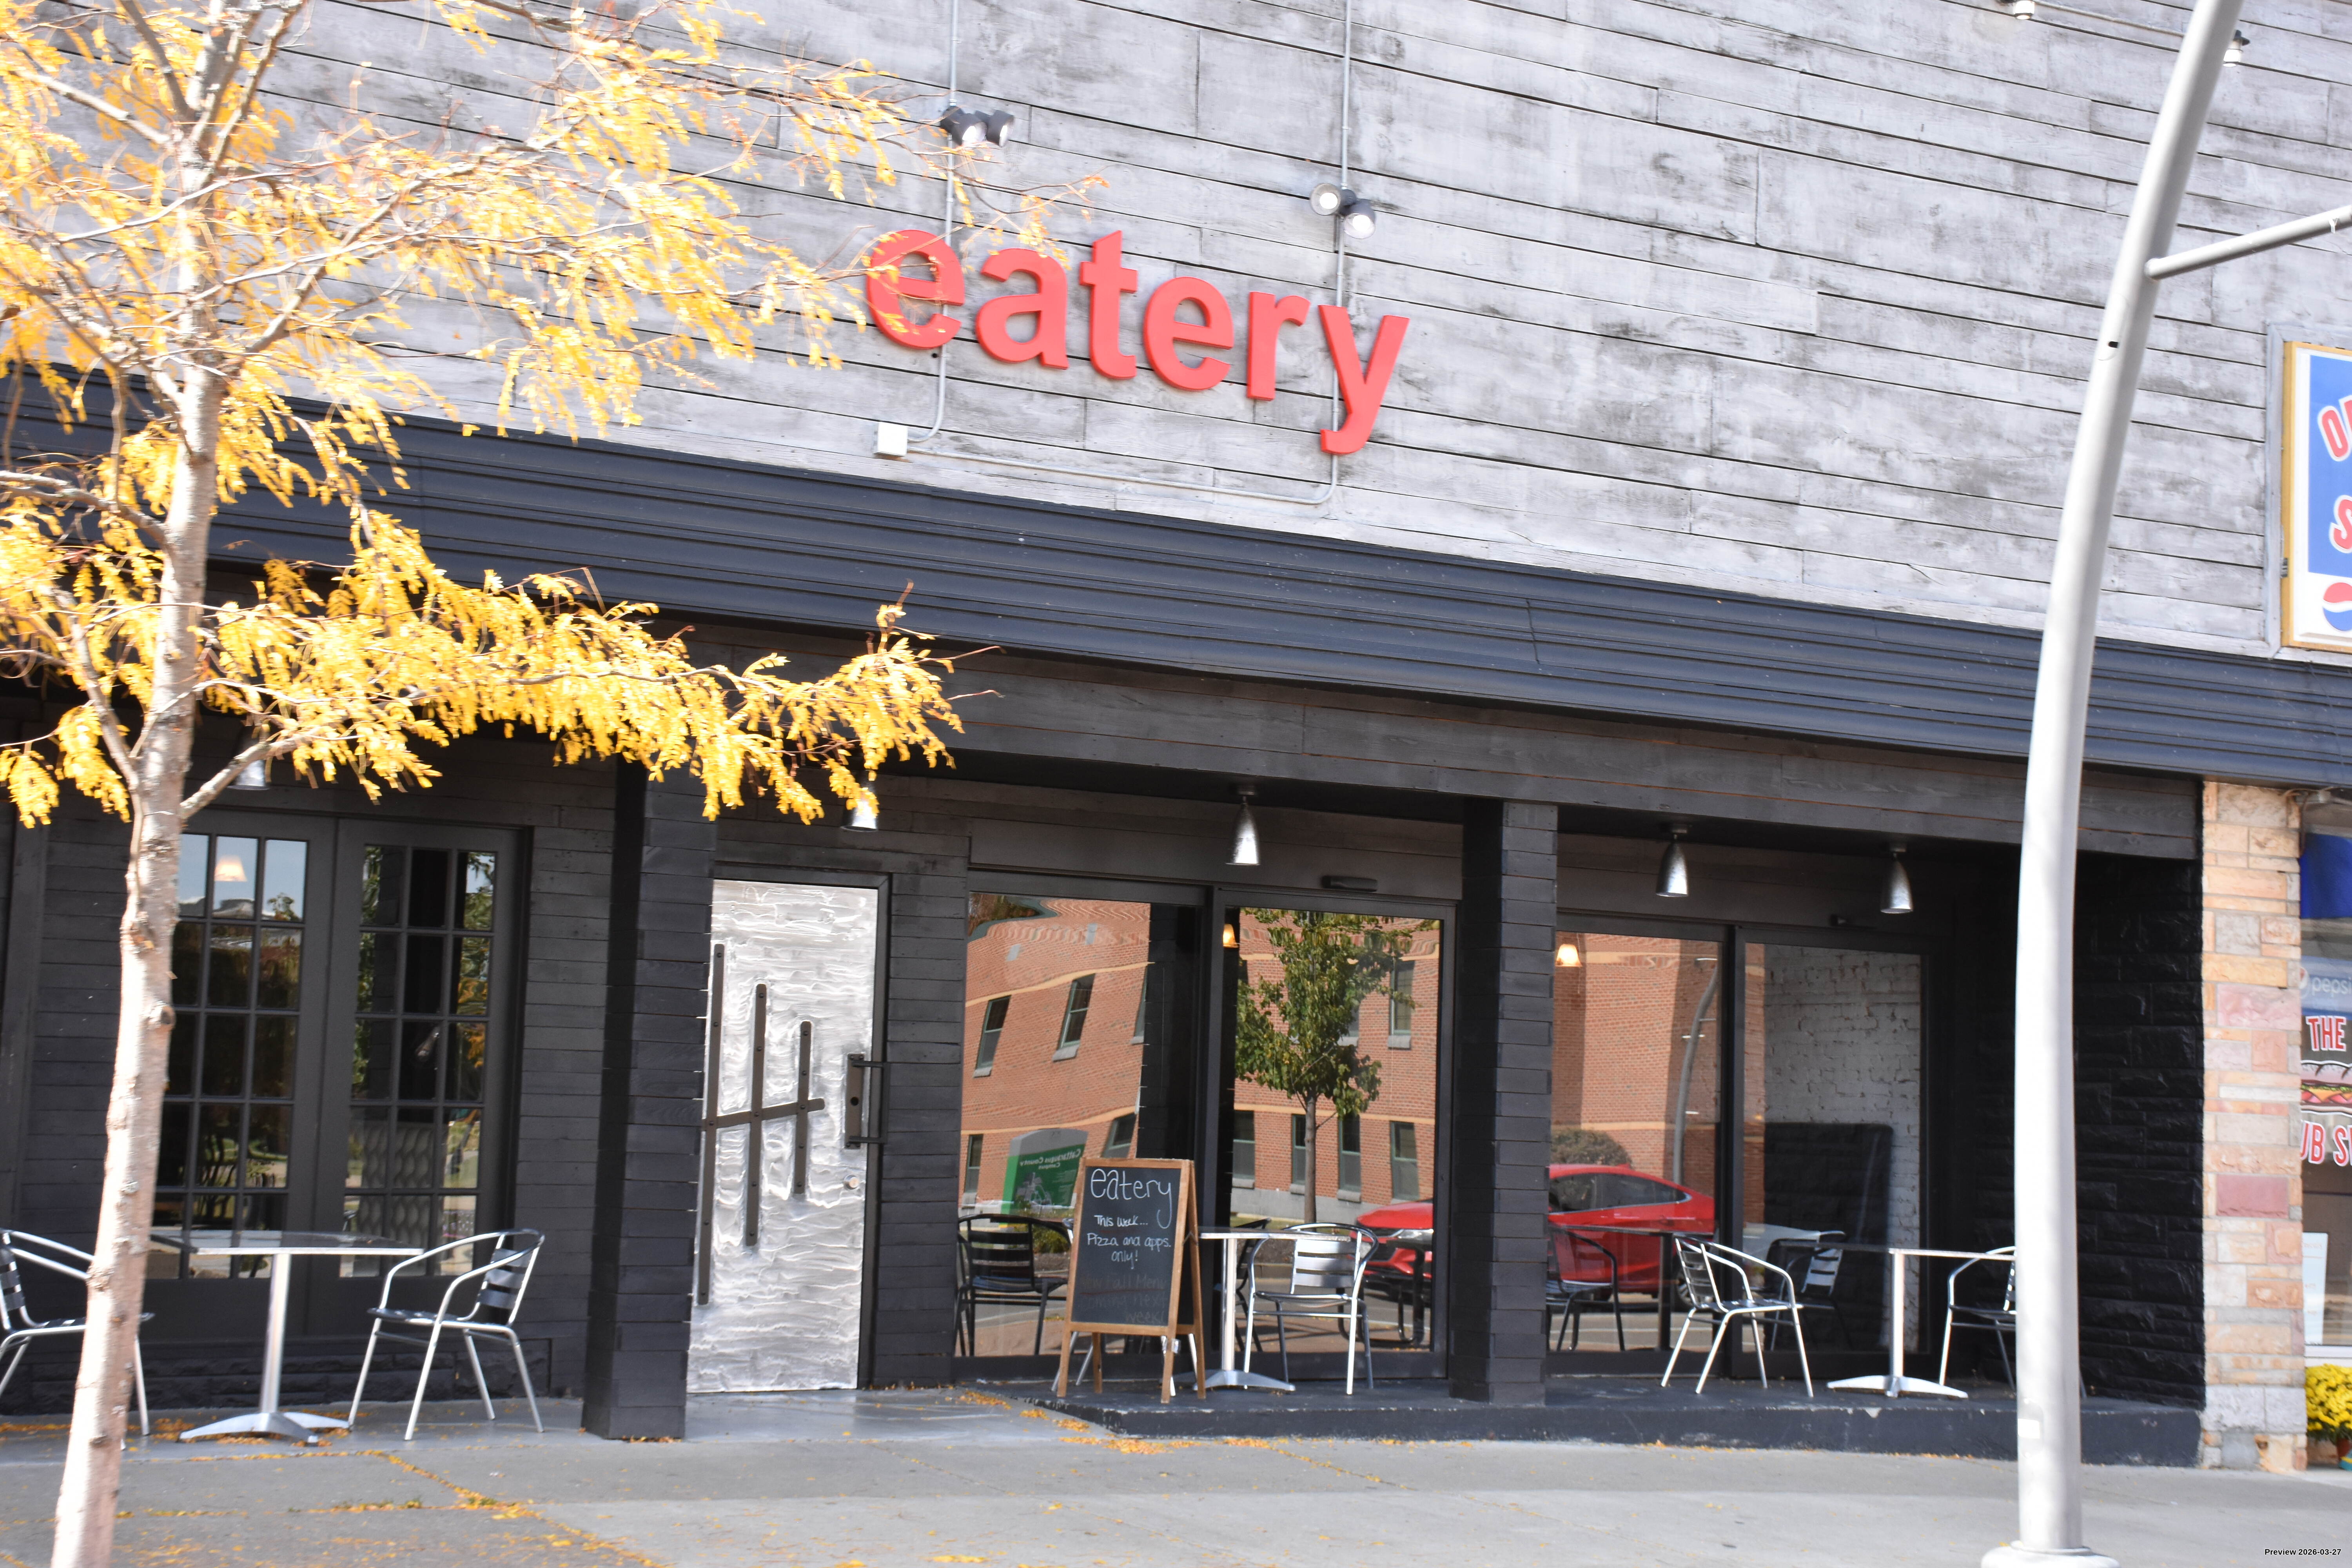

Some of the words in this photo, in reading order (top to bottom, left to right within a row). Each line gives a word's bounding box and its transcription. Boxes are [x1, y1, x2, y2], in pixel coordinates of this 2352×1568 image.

[867, 229, 1410, 456] eatery
[2312, 976, 2352, 997] pepsi
[2305, 1015, 2347, 1051] THE
[2333, 1125, 2352, 1167] S
[1091, 1169, 1172, 1229] eatery
[1094, 1215, 1114, 1227] This
[1087, 1232, 1119, 1246] Pizza
[1123, 1236, 1141, 1246] and
[1111, 1249, 1138, 1270] only!
